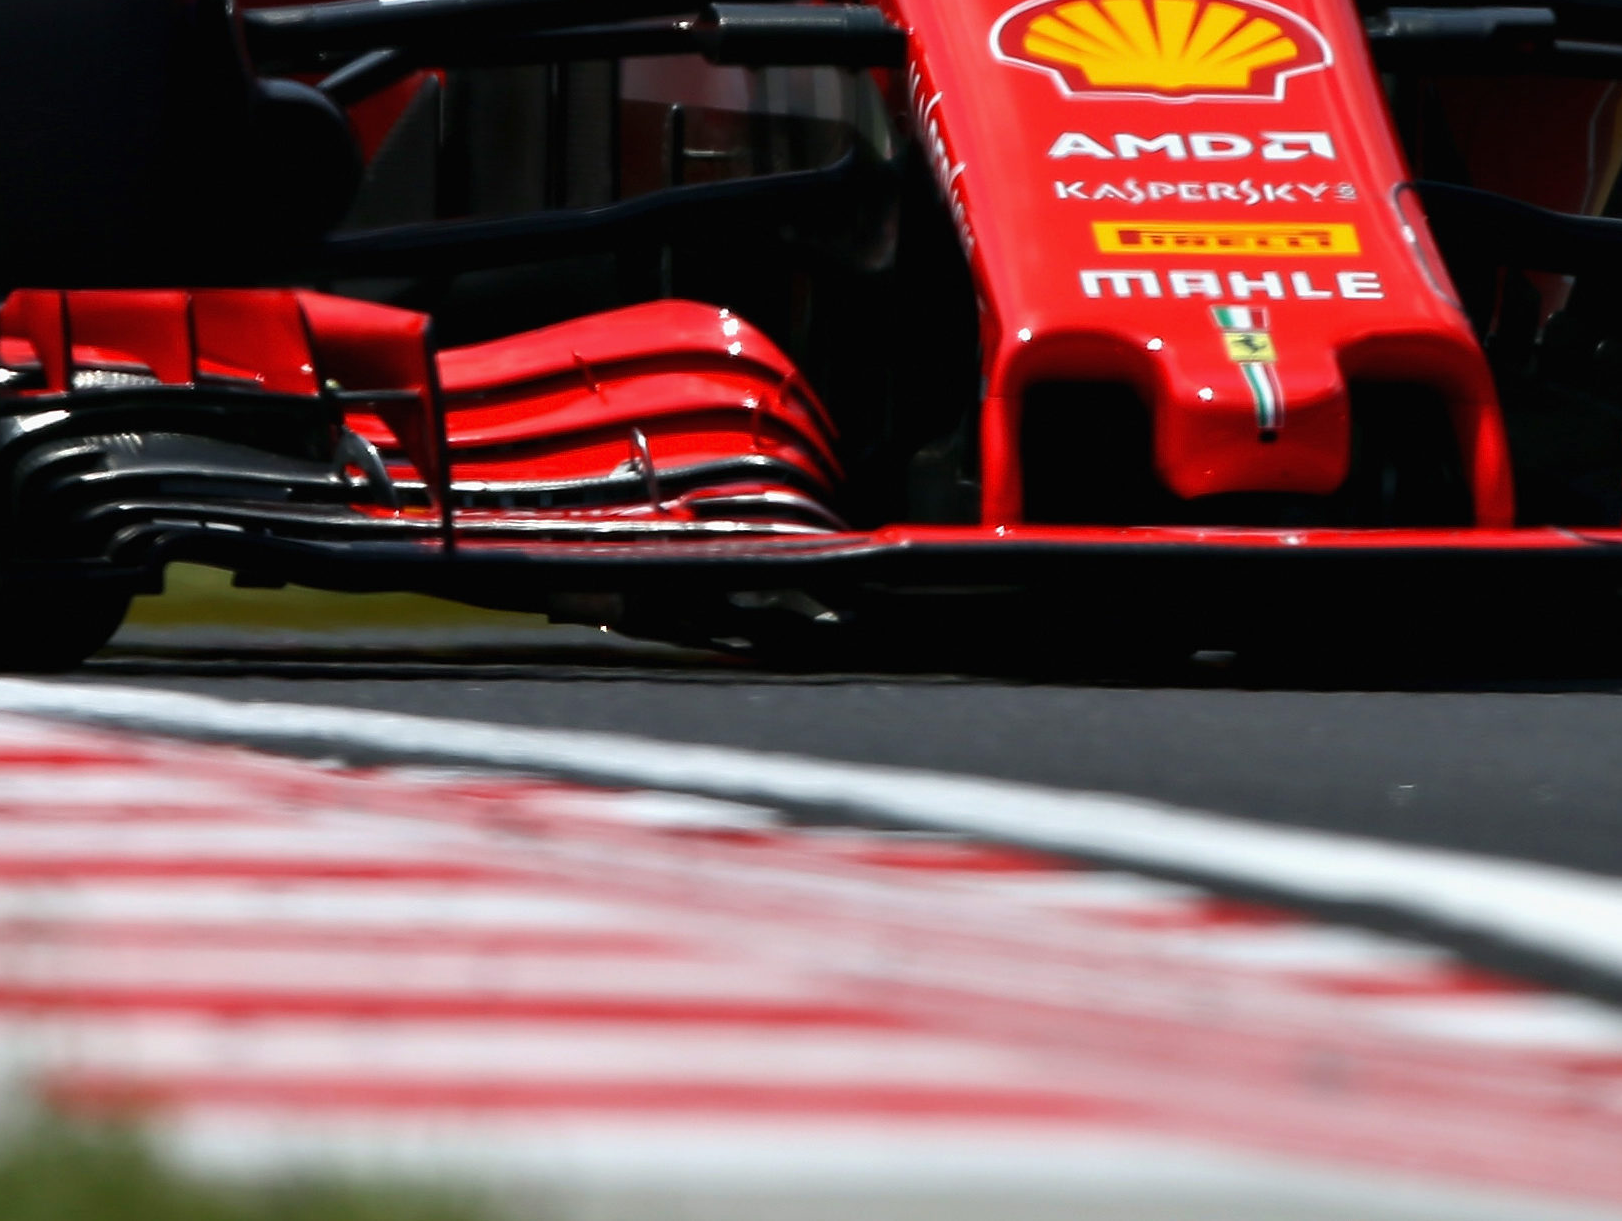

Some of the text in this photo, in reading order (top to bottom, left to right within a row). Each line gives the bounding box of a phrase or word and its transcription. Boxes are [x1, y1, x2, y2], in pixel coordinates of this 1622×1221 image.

[1048, 131, 1255, 161] AMD
[1054, 179, 1328, 205] KASPERSKY
[1079, 269, 1385, 299] MAHLE
